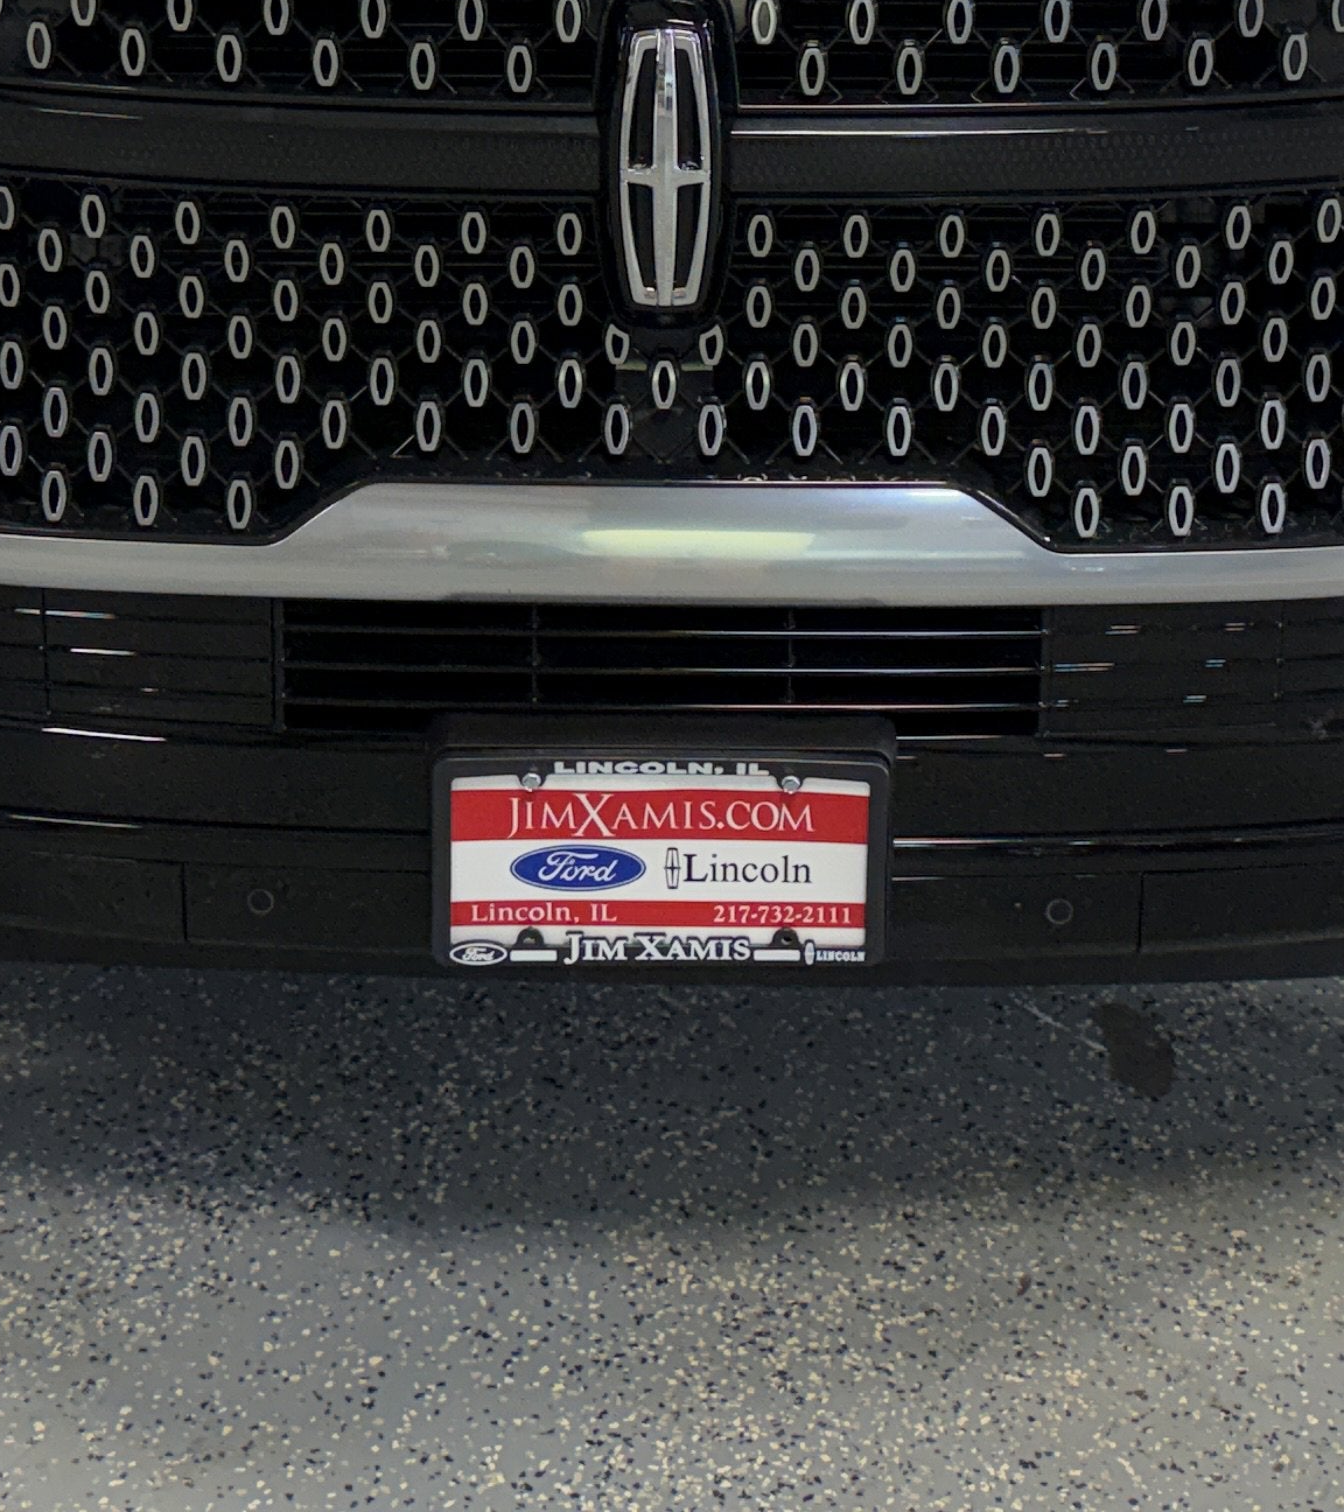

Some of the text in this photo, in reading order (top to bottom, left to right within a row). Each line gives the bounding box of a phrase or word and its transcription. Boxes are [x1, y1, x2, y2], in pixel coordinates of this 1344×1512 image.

[554, 761, 770, 776] LINCOLN, IL
[508, 793, 815, 838] JIMXAMIS.COM
[538, 851, 618, 881] Ford
[683, 853, 813, 883] Lincoln
[471, 902, 617, 924] Lincoln, IL
[713, 905, 851, 924] 217-732-2111
[563, 933, 751, 964] JIM XAMIS
[816, 951, 865, 962] LINCOLN
